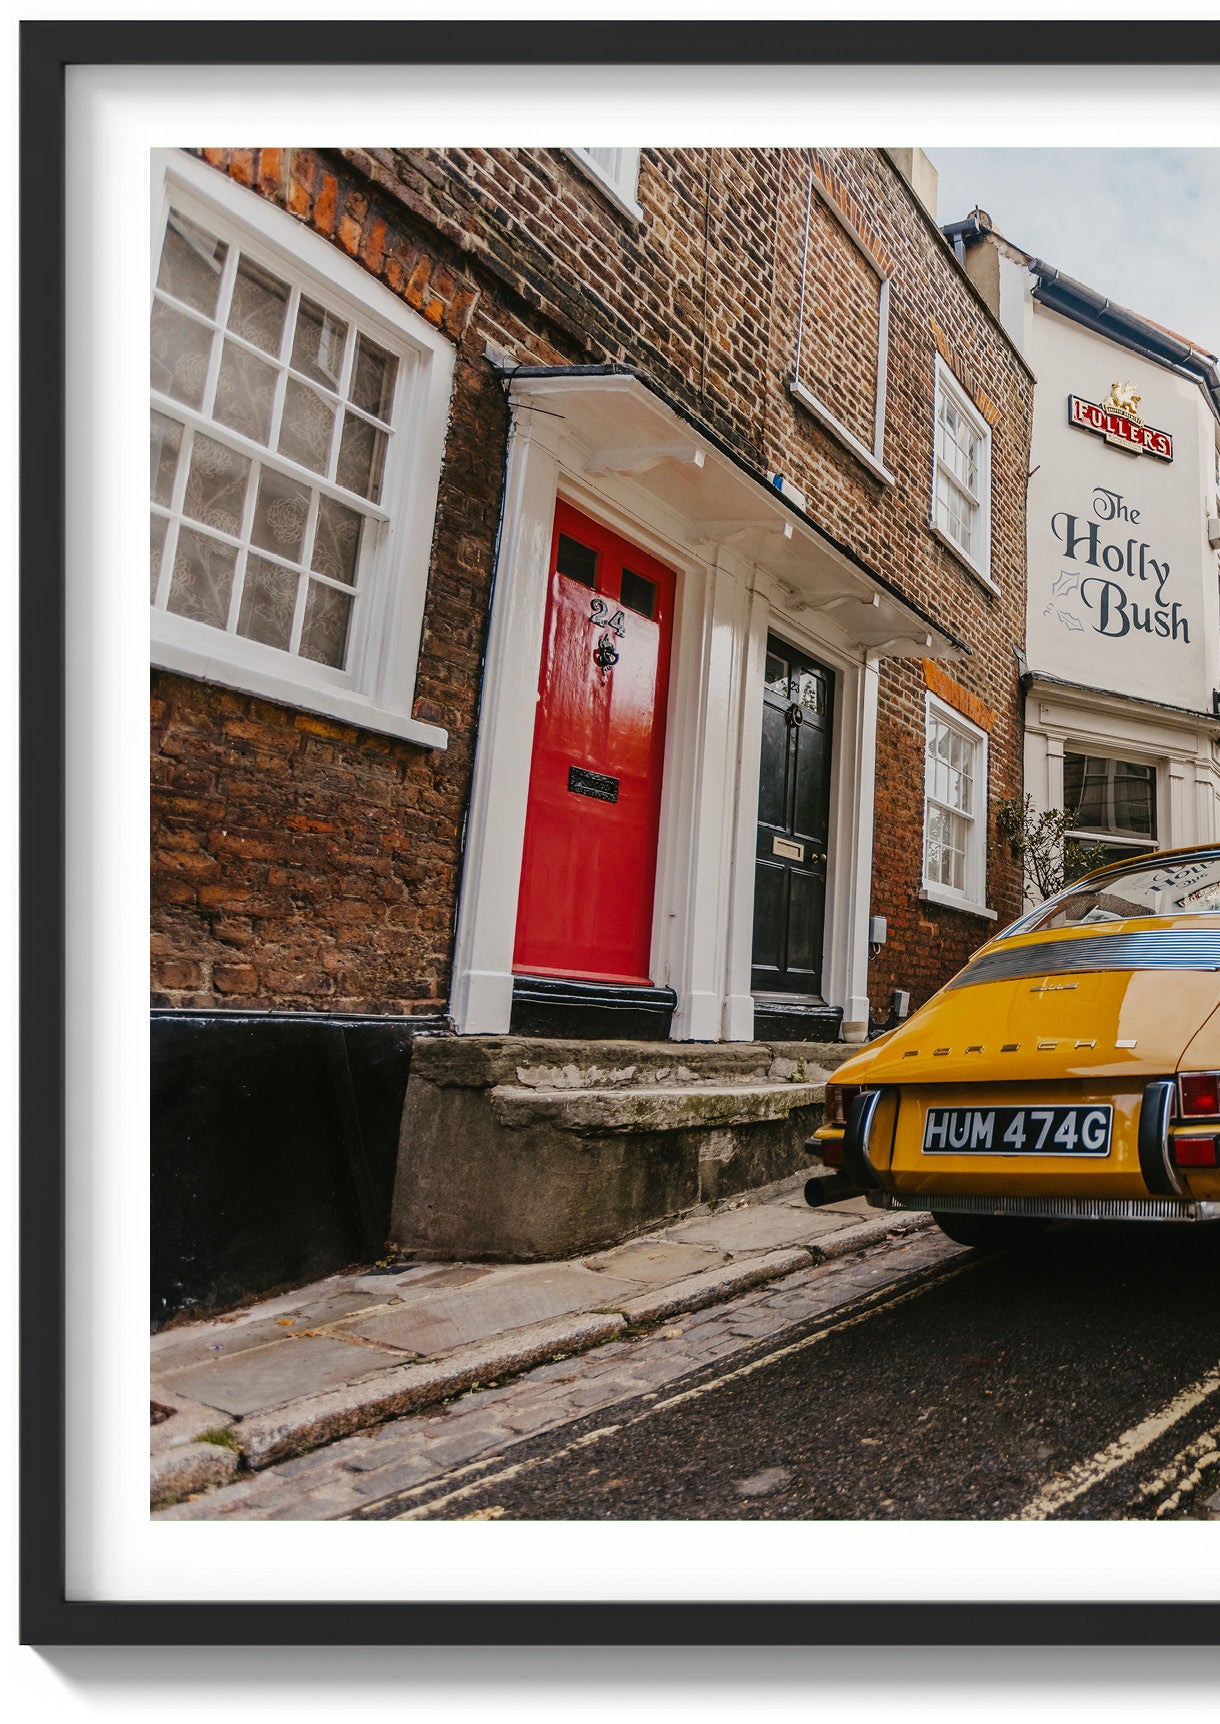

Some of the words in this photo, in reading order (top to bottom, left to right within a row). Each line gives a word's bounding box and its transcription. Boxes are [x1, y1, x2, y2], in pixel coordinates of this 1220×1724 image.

[1093, 486, 1141, 525] The
[1051, 512, 1170, 607] Holly
[589, 598, 626, 638] 24
[1080, 577, 1191, 644] Bush
[790, 680, 800, 694] 23
[925, 1111, 996, 1149] HUM
[1003, 1110, 1107, 1150] 474G
